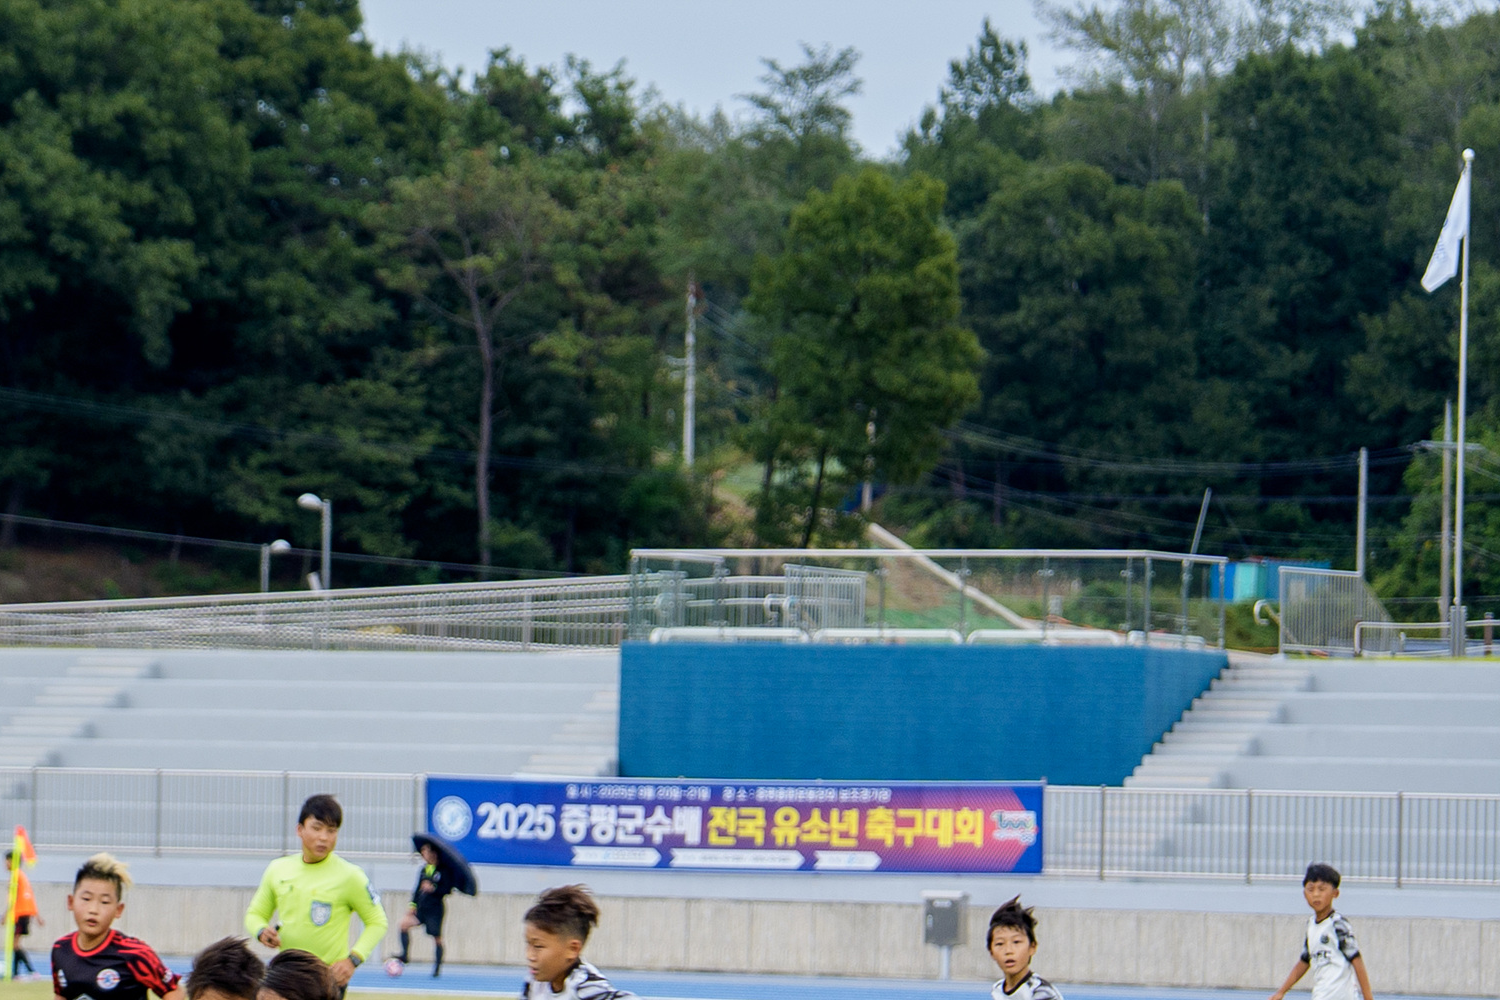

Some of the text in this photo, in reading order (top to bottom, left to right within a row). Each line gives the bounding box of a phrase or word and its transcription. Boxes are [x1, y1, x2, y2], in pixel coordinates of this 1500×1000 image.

[476, 802, 556, 840] 2025
[560, 803, 703, 845] 증평군수배
[707, 806, 766, 846] 전국
[772, 806, 859, 848] 유소년
[865, 807, 984, 848] 축구대회
